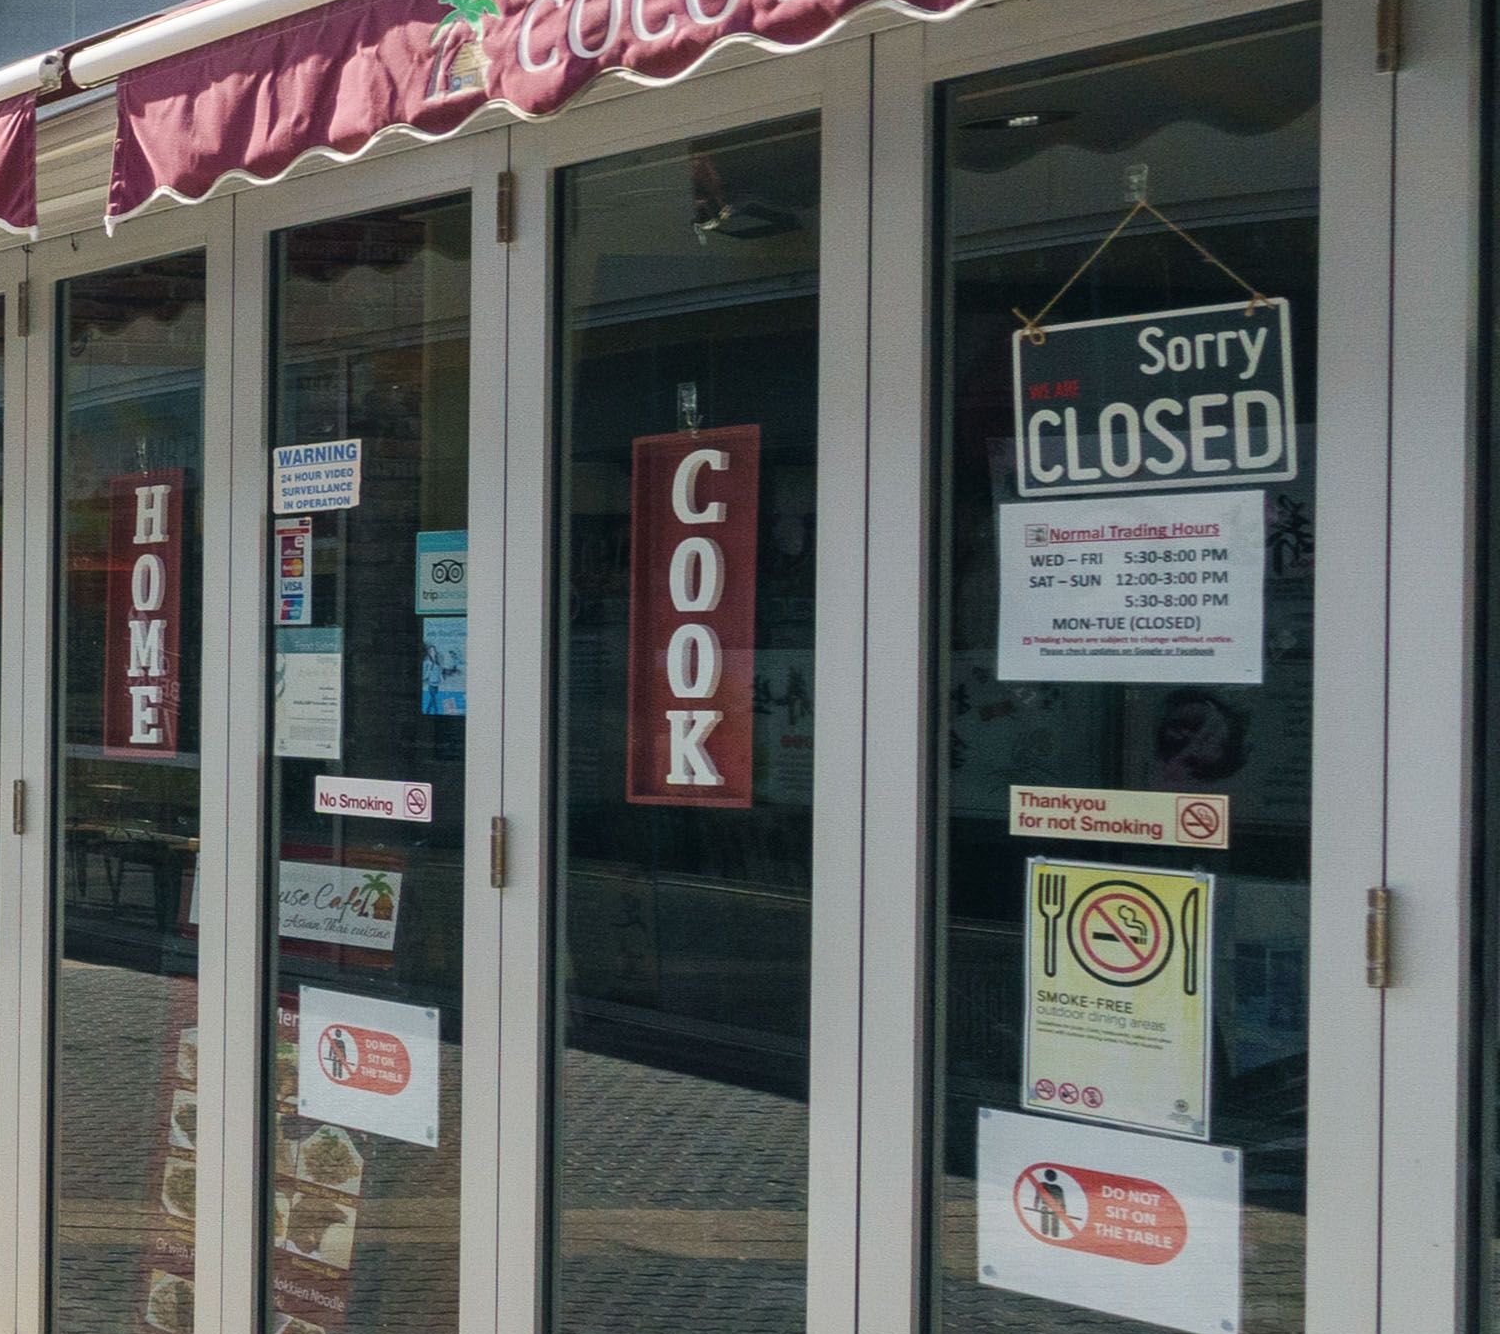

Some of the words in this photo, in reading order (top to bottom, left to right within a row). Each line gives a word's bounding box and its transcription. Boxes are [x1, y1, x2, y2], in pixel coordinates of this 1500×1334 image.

[1137, 326, 1268, 380] Sorry
[1028, 389, 1283, 483] CLOSED
[278, 443, 358, 466] WARNING
[280, 473, 292, 484] 24
[294, 469, 322, 482] HOUR
[324, 467, 354, 479] VIDEO
[282, 482, 353, 497] SURVEILLANCE
[283, 500, 294, 510] IN
[296, 495, 351, 509] OPERATION
[1050, 525, 1105, 540] Normal
[1108, 524, 1168, 540] Trading
[1171, 522, 1220, 536] Hours
[1030, 553, 1064, 567] WED
[1080, 552, 1103, 565] FRI
[1124, 549, 1197, 564] 5:30-8:00
[1201, 548, 1228, 562] PM
[283, 580, 303, 591] VISA
[1029, 575, 1054, 588] SAT
[1069, 574, 1102, 587] SUN
[1116, 571, 1197, 586] 12:00-3:00
[1202, 570, 1229, 584] PM
[1124, 594, 1198, 607] 5:30-8:00
[1202, 593, 1229, 607] PM
[126, 483, 172, 745] HOME
[665, 448, 731, 787] COOK
[1052, 616, 1126, 631] MON-TUE
[1130, 615, 1202, 632] (CLOSED)
[1033, 636, 1060, 645] Trading
[1062, 636, 1084, 644] hours
[1099, 636, 1129, 646] subject
[1130, 636, 1139, 644] to
[1140, 636, 1170, 645] change
[1172, 635, 1204, 644] without
[1039, 646, 1059, 655] Please
[1060, 646, 1087, 655] check
[1092, 646, 1120, 656] updates
[1121, 647, 1133, 655] on
[1134, 646, 1164, 656] Google
[1165, 647, 1174, 655] or
[1175, 646, 1215, 656] Facebook
[319, 791, 337, 808] No
[338, 794, 394, 815] Smoking
[1018, 792, 1107, 813] Thankyou
[1018, 814, 1043, 828] for
[1047, 816, 1076, 831] not
[1080, 816, 1163, 840] Smoking
[314, 882, 364, 923] Cafe
[1037, 990, 1134, 1015] SMOKE-FREE
[1036, 1005, 1086, 1019] outdoor
[1088, 1010, 1128, 1029] dining
[1129, 1018, 1167, 1032] areas
[365, 1038, 379, 1050] DO
[379, 1040, 397, 1053] NOT
[368, 1053, 380, 1064] SIT
[380, 1056, 395, 1067] ON
[361, 1067, 378, 1078] THE
[378, 1070, 403, 1084] TABLE
[1102, 1185, 1125, 1201] DO
[1128, 1190, 1161, 1207] NOT
[1106, 1205, 1129, 1220] SIT
[1131, 1210, 1157, 1226] ON
[1093, 1222, 1123, 1240] THE
[1124, 1228, 1173, 1250] TABLE
[310, 1289, 345, 1313] Noodle
